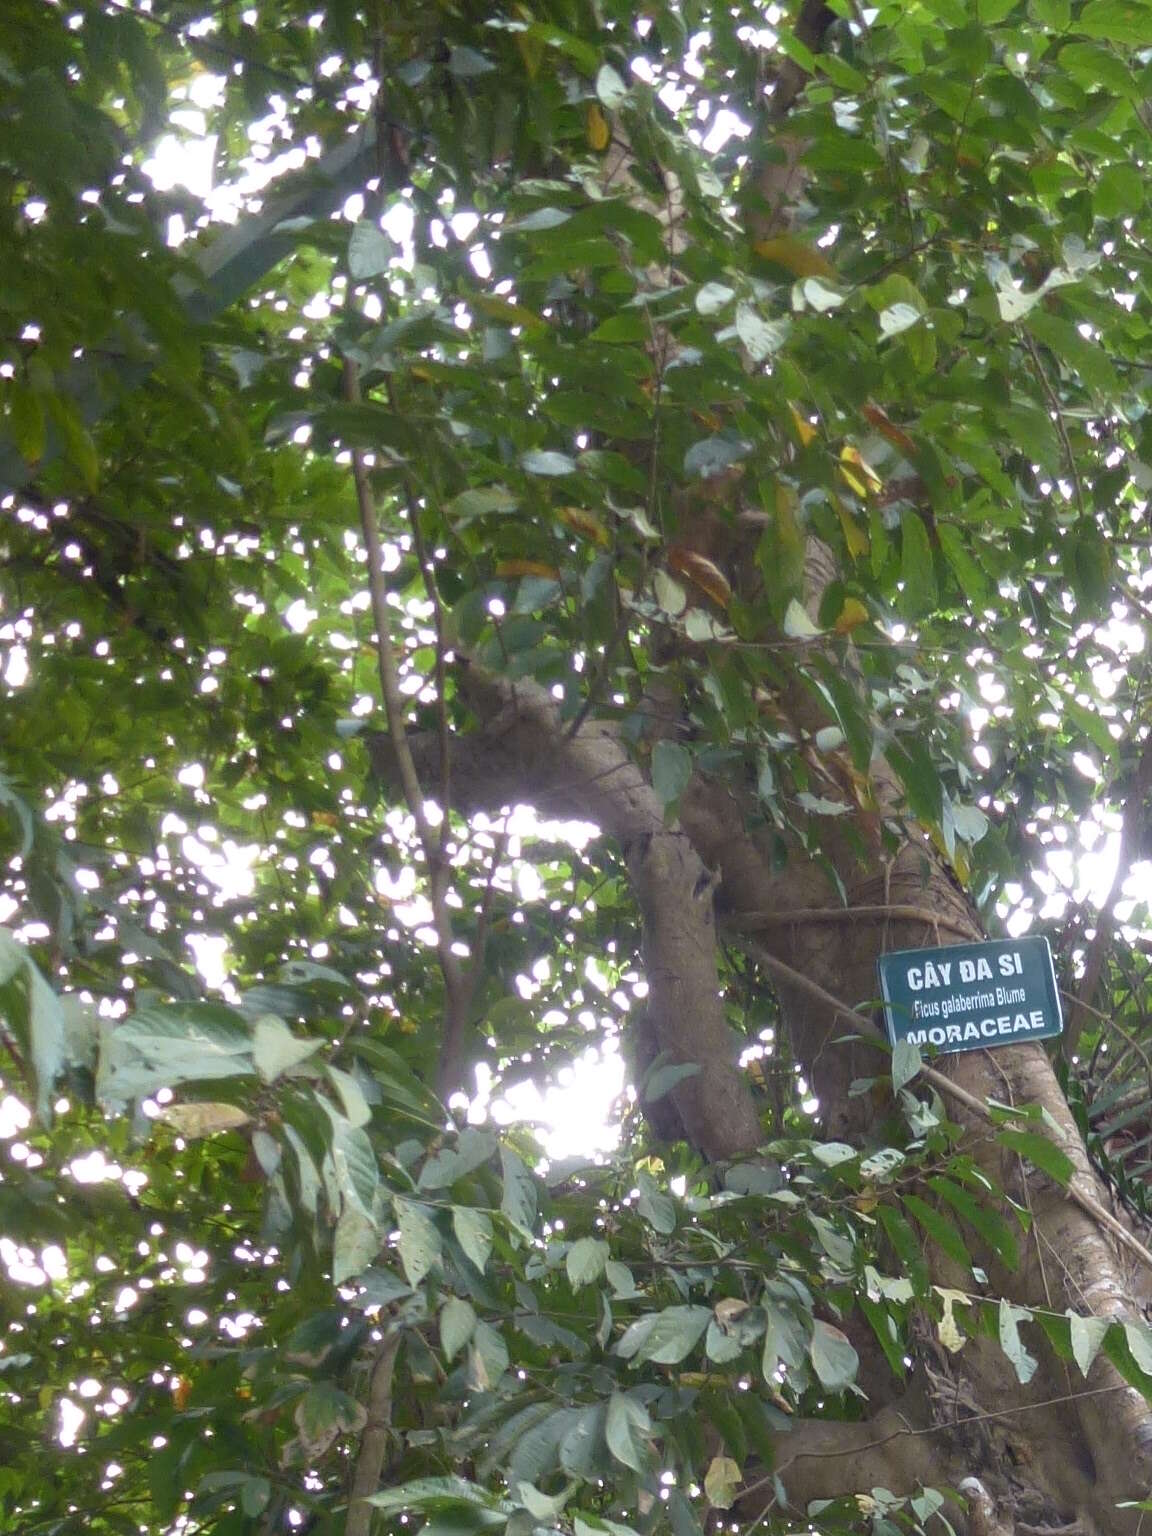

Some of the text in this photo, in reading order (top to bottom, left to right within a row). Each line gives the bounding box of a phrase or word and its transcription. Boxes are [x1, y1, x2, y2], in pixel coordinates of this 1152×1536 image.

[907, 952, 1023, 991] CÂY ĐA SI
[942, 991, 995, 1018] galaberrima
[996, 987, 1026, 1006] Blume
[907, 1011, 1045, 1046] MORACEAE
